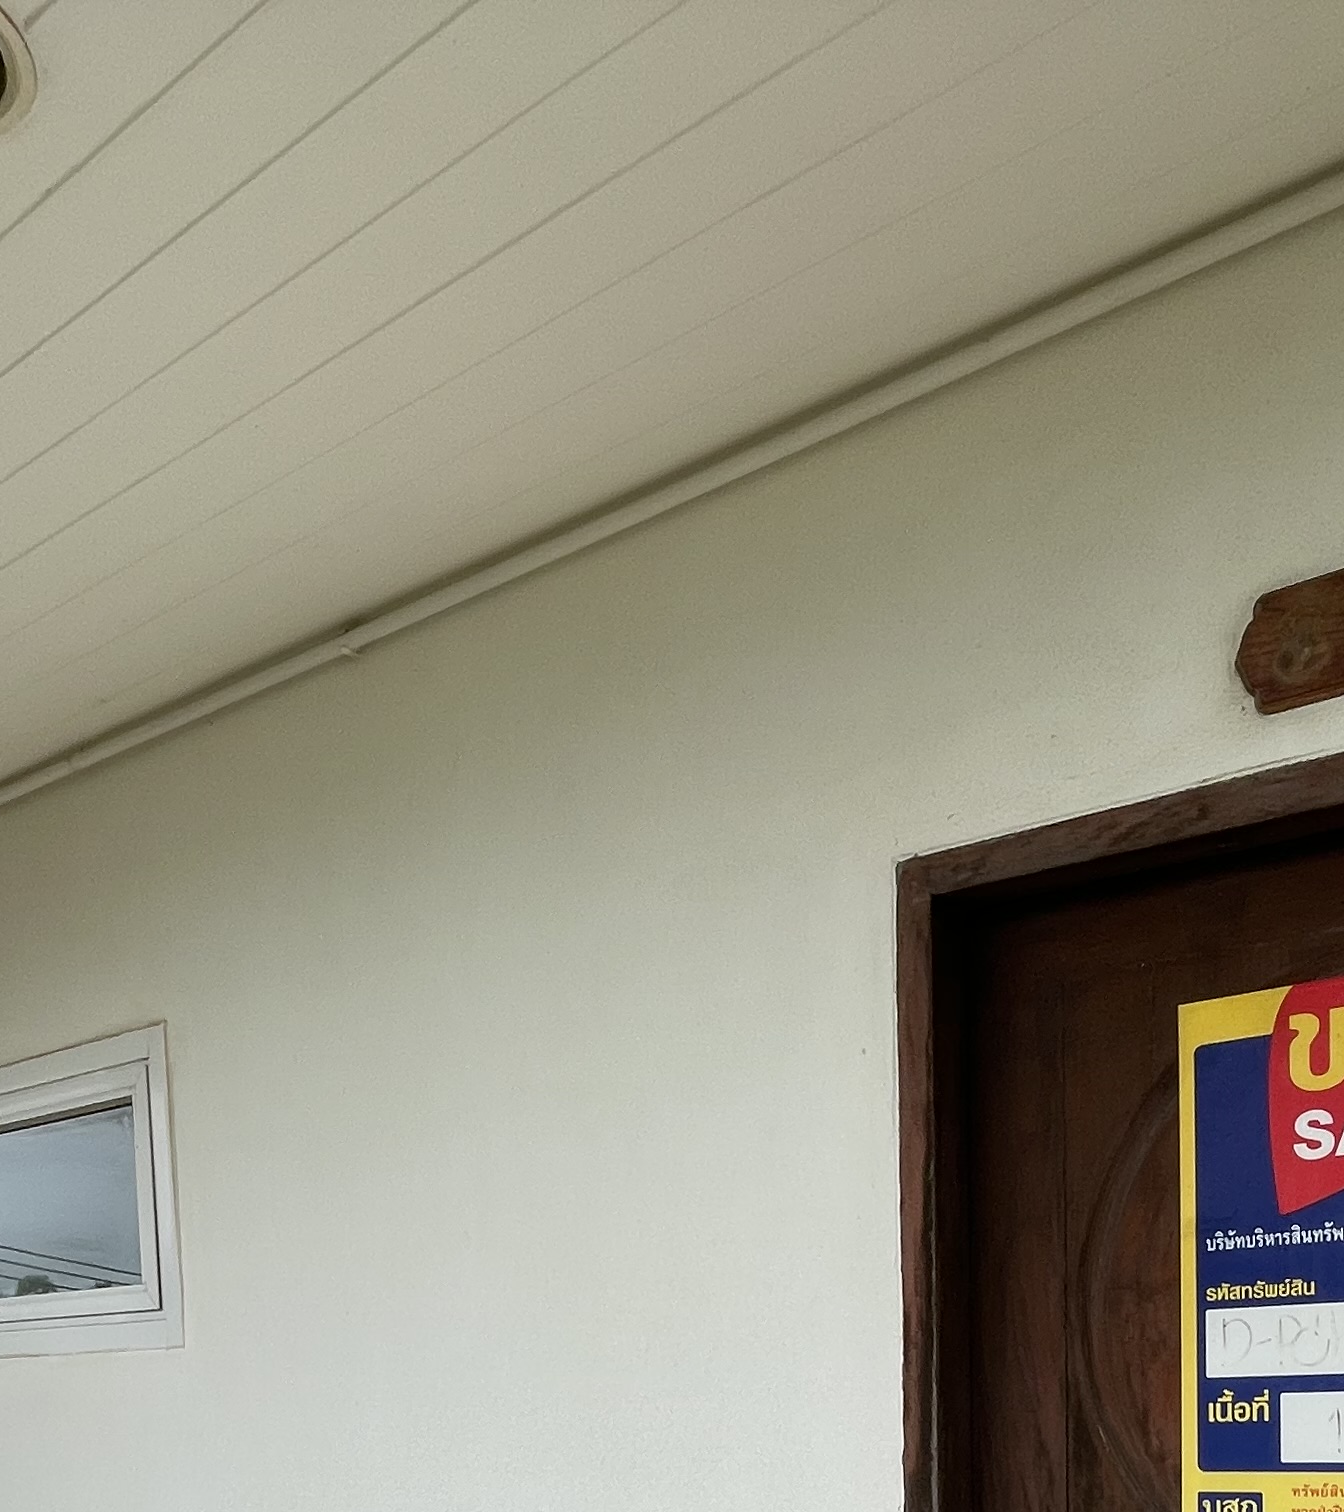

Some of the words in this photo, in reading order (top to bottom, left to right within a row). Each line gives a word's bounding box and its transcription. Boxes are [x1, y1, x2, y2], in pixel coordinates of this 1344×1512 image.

[1206, 1278, 1316, 1302] รหัสทรัพย์สิน
[1208, 1388, 1270, 1423] เนื้อที่
